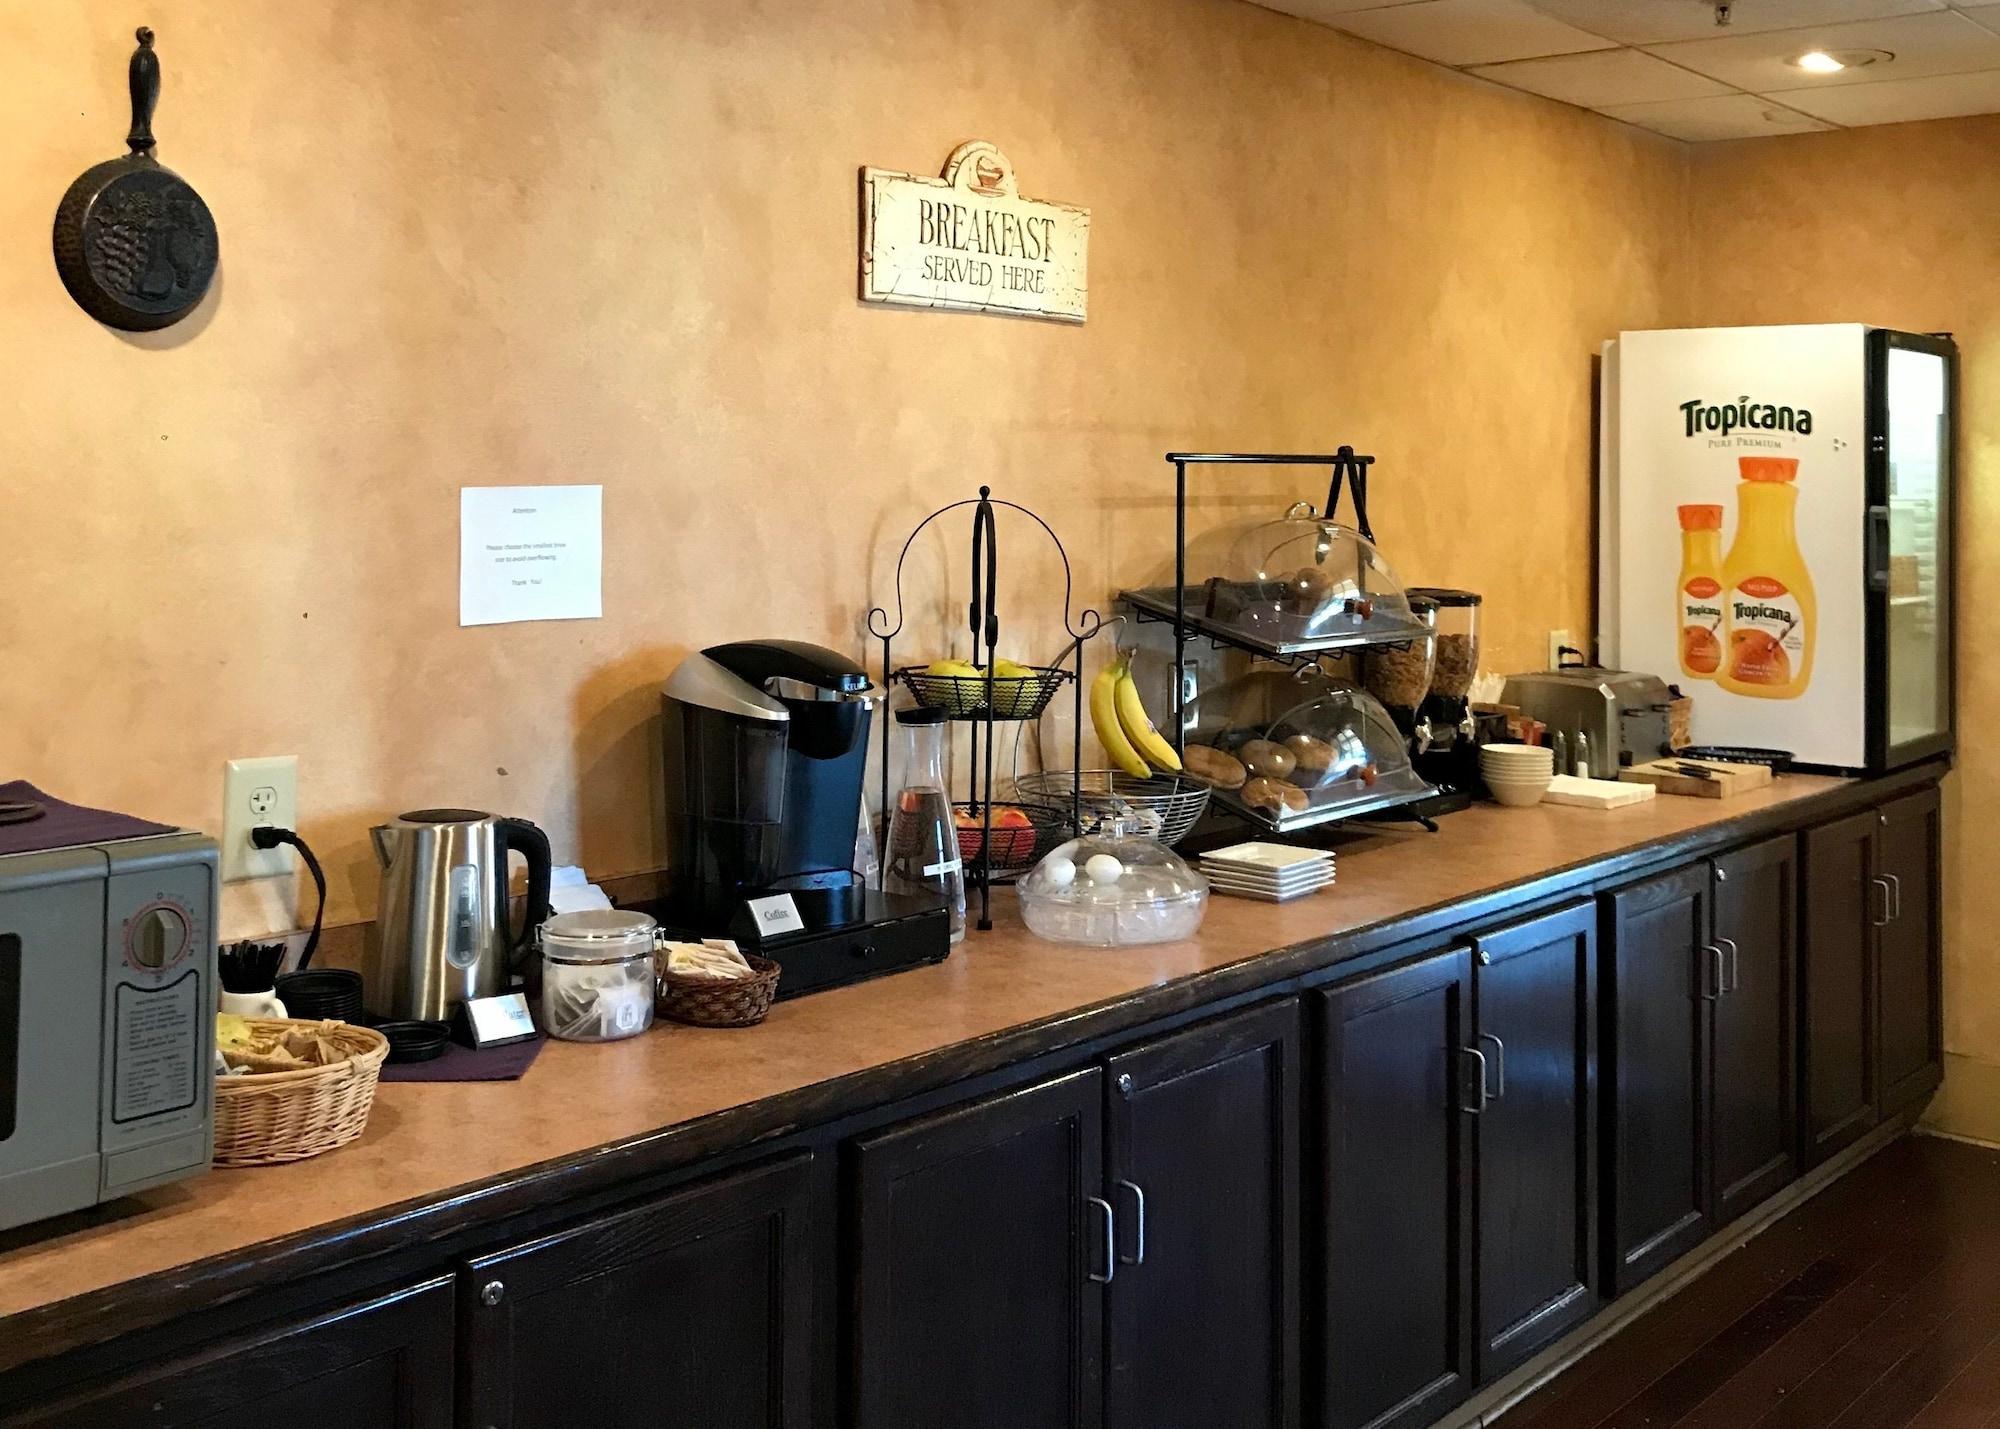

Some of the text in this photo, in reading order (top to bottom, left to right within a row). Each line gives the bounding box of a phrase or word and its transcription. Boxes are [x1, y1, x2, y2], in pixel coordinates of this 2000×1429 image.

[919, 198, 1055, 262] BREAKFAST
[922, 256, 1045, 294] SERVED HERE
[1680, 395, 1812, 437] Tropicana
[1733, 602, 1791, 623] Tropicana
